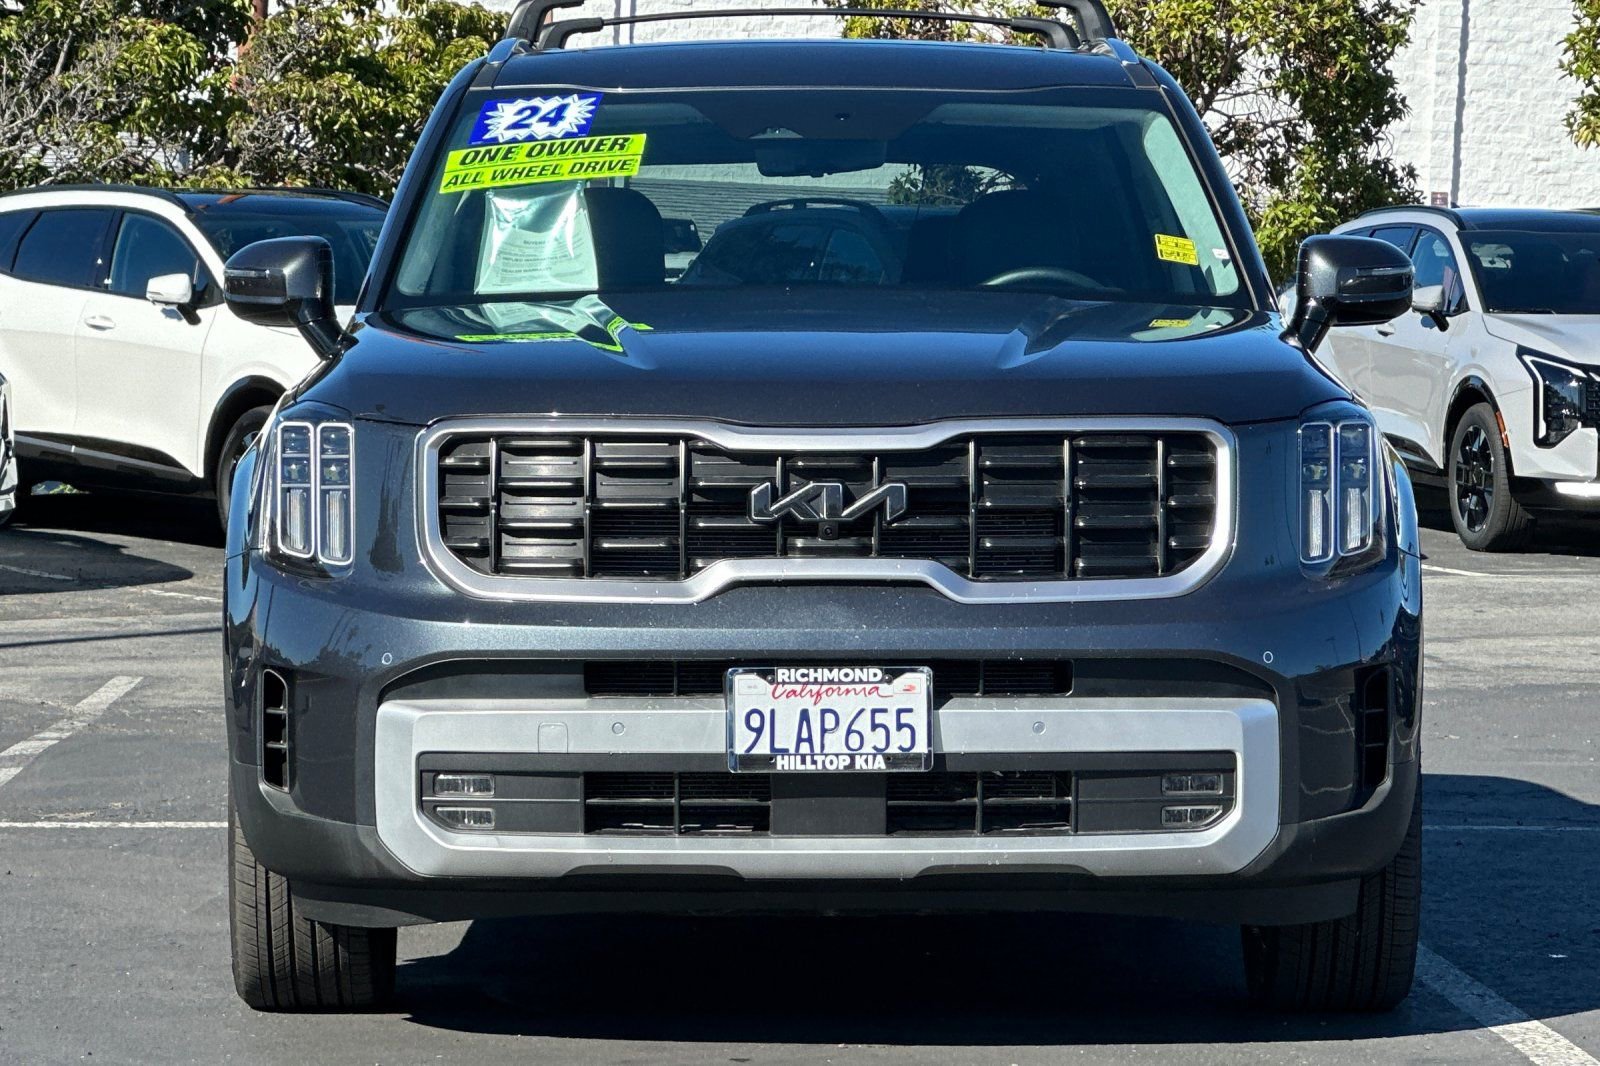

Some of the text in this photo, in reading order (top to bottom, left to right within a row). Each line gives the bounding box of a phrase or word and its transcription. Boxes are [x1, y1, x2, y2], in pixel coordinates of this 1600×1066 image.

[504, 102, 571, 130] 24
[459, 136, 633, 166] ONE OWNER
[444, 159, 636, 188] ALL WHEEL DRIVE
[749, 481, 908, 522] KIA
[777, 668, 882, 683] RICHMOND
[772, 683, 893, 705] California
[744, 708, 916, 753] 9LAP655
[777, 755, 886, 770] HILLTOP KIA
